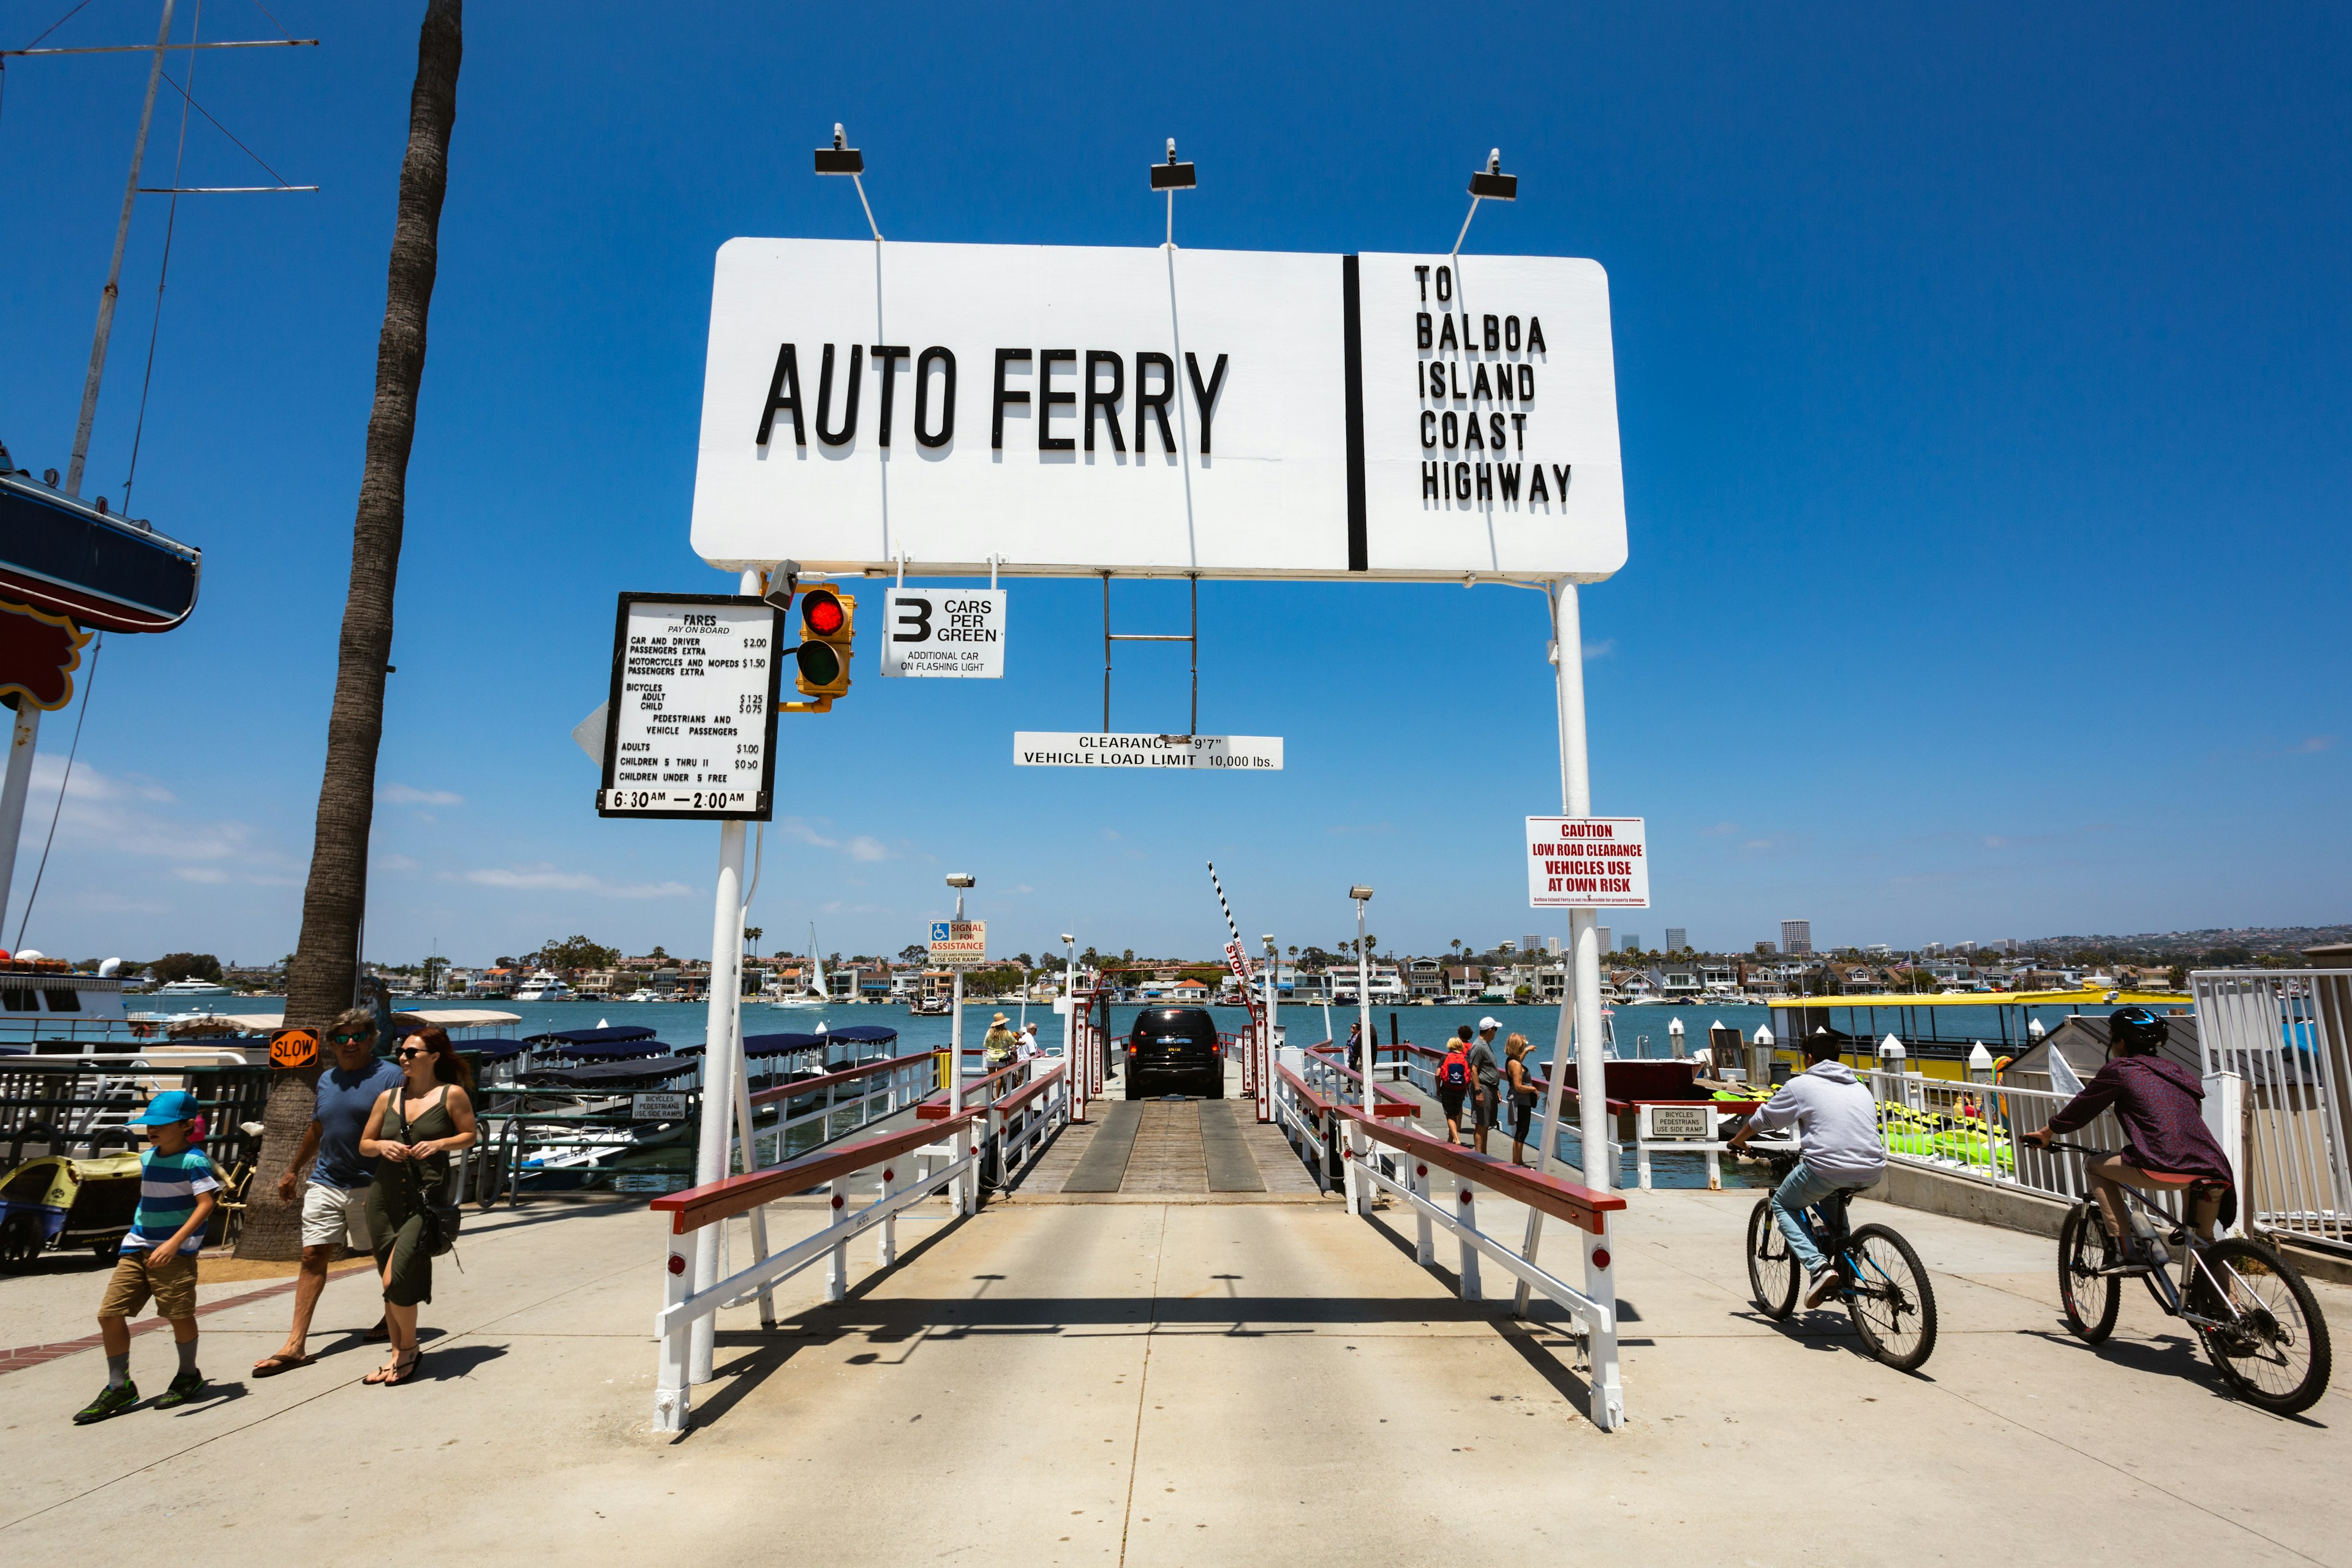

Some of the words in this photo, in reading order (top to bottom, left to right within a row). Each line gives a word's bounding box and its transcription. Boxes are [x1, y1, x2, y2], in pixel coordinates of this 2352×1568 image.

[1415, 266, 1452, 302] TO
[1417, 312, 1546, 353] BALBOA
[1419, 361, 1534, 401] ISLAND
[756, 344, 956, 448] AUTO
[992, 349, 1228, 454] FERRY
[1420, 410, 1526, 451] COAST
[1422, 461, 1570, 502] HIGHWAY
[945, 600, 991, 613] CARS
[684, 615, 716, 625] FARES
[893, 598, 932, 642] 3
[951, 615, 983, 627] PER
[938, 628, 996, 641] GREEN
[630, 646, 677, 655] PASSENGERS
[628, 667, 674, 676] PASSENGERS
[1025, 753, 1093, 763] VEHICLE
[1101, 753, 1144, 765] LOAD
[1152, 755, 1196, 766] LIMIT
[1208, 756, 1248, 768] 10,000
[1253, 756, 1273, 767] lbs.
[615, 792, 648, 807] 6:30
[694, 793, 726, 808] 2:00
[1562, 824, 1611, 837] CAUTION
[1533, 844, 1554, 855] LOW
[1558, 844, 1583, 856] ROAD
[1587, 845, 1642, 856] CLEARANCE
[1545, 861, 1604, 875] VEHICLES
[1608, 862, 1631, 875] USE
[1549, 878, 1562, 891] AT
[1567, 878, 1596, 891] OWN
[1600, 878, 1630, 892] RISK
[1226, 945, 1245, 977] STOP
[274, 1039, 313, 1057] SLOW
